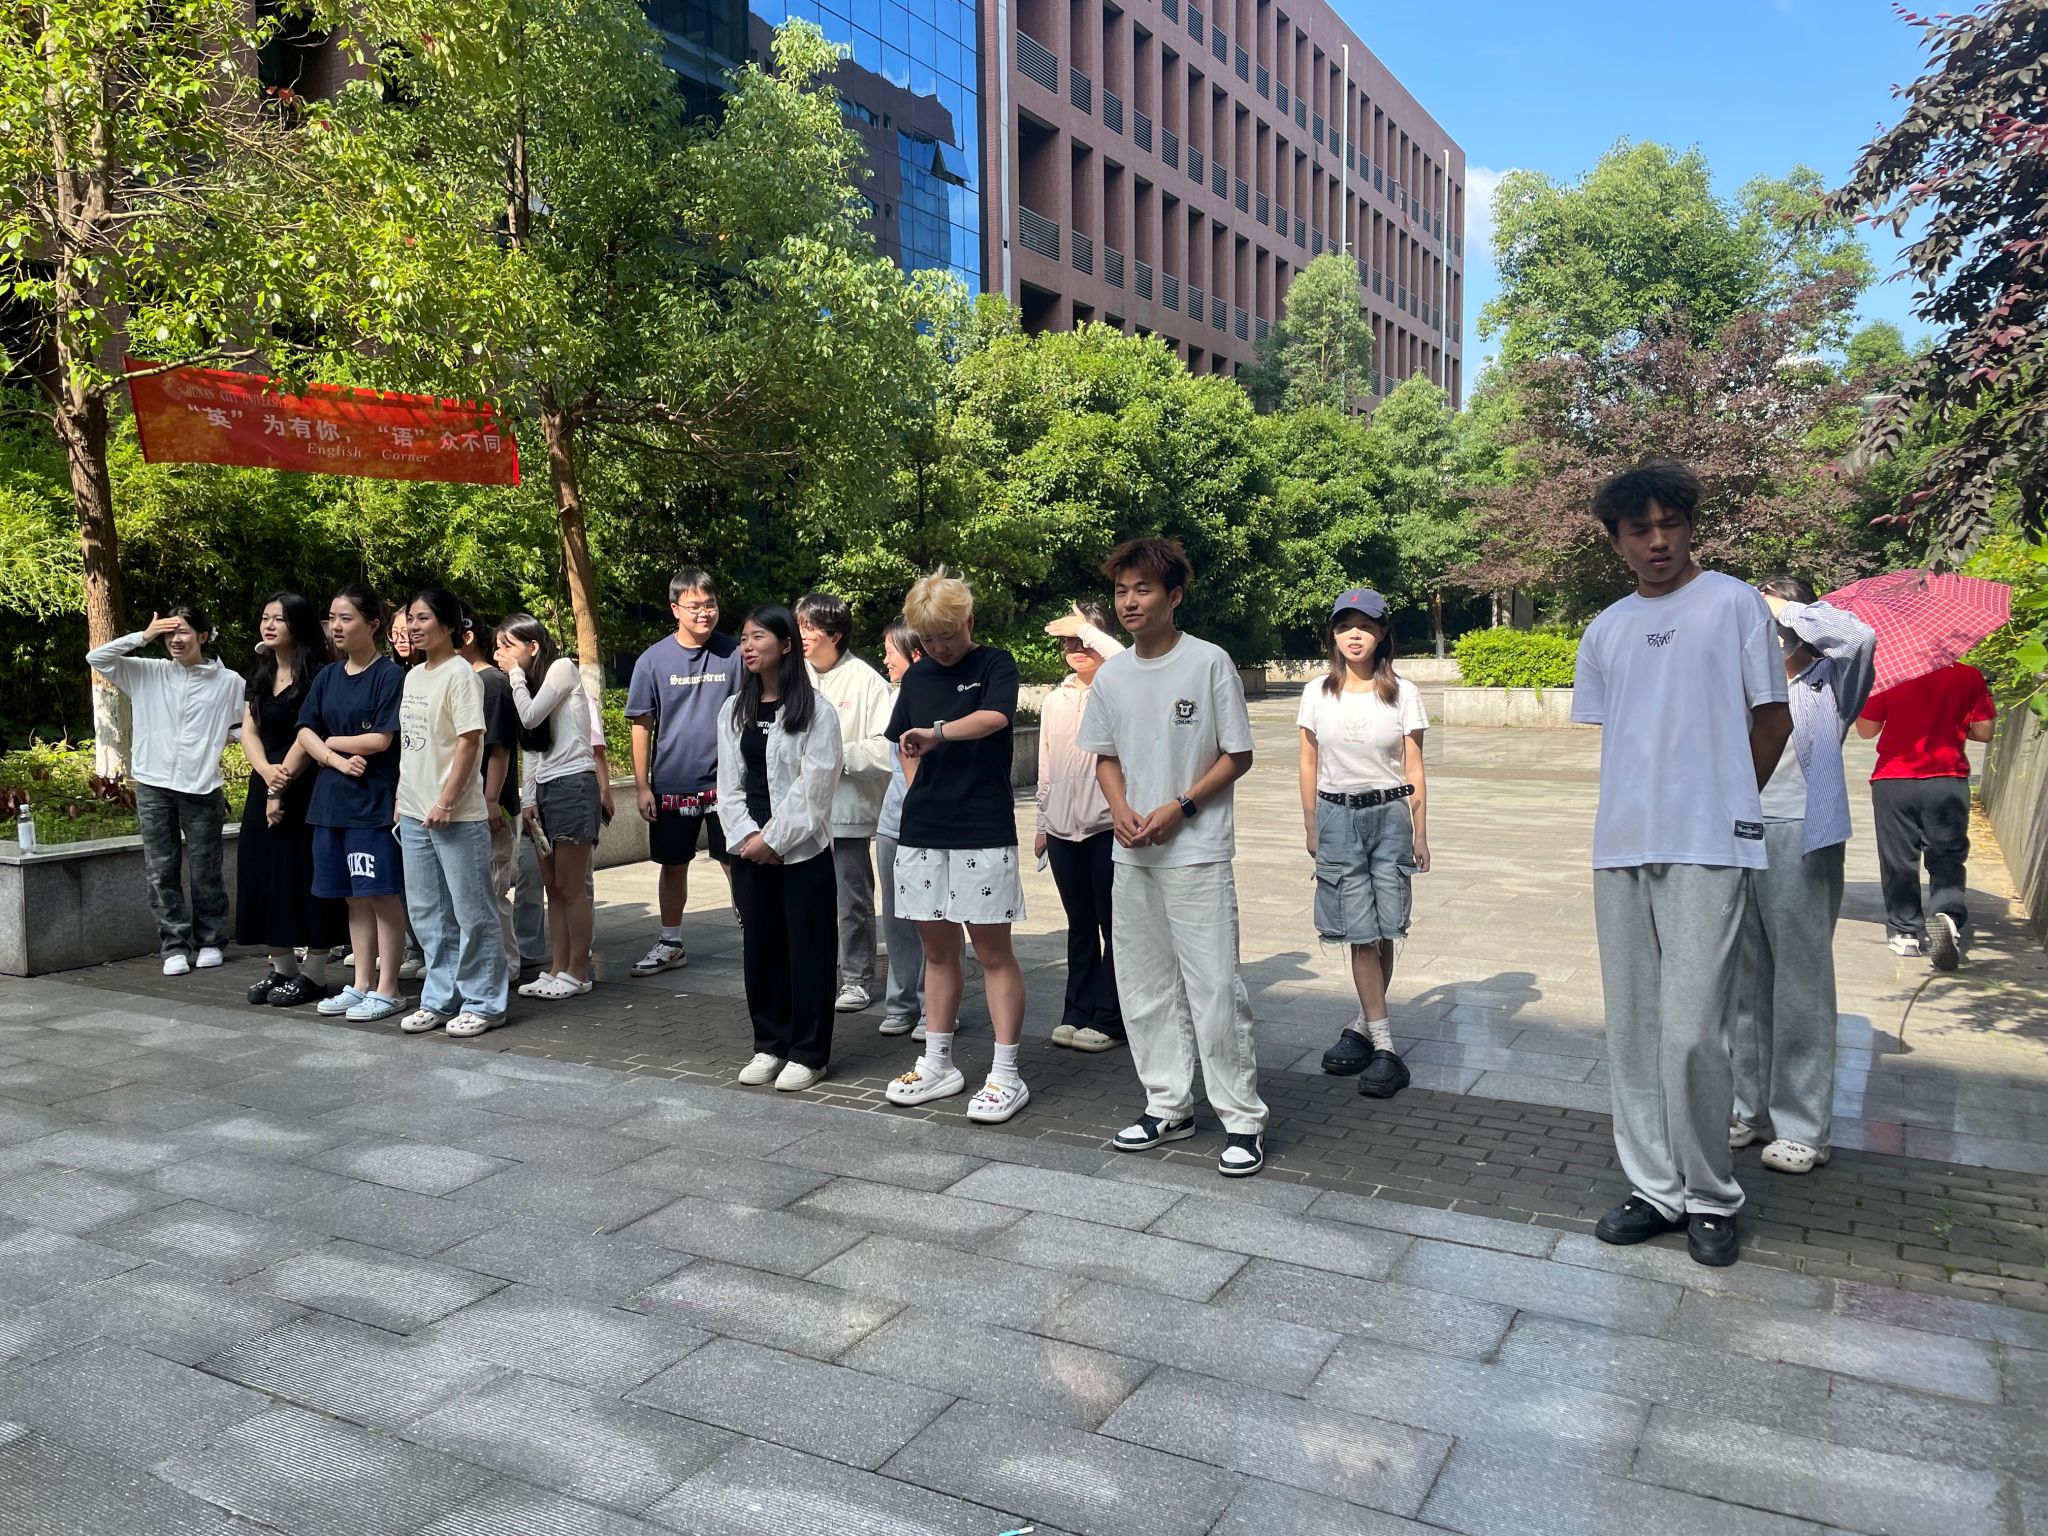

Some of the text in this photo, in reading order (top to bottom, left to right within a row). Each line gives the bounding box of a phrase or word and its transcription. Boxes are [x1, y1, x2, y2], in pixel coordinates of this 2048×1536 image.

[184, 384, 215, 399] HUNAN
[220, 390, 239, 404] CITY
[307, 442, 430, 463] English Corner
